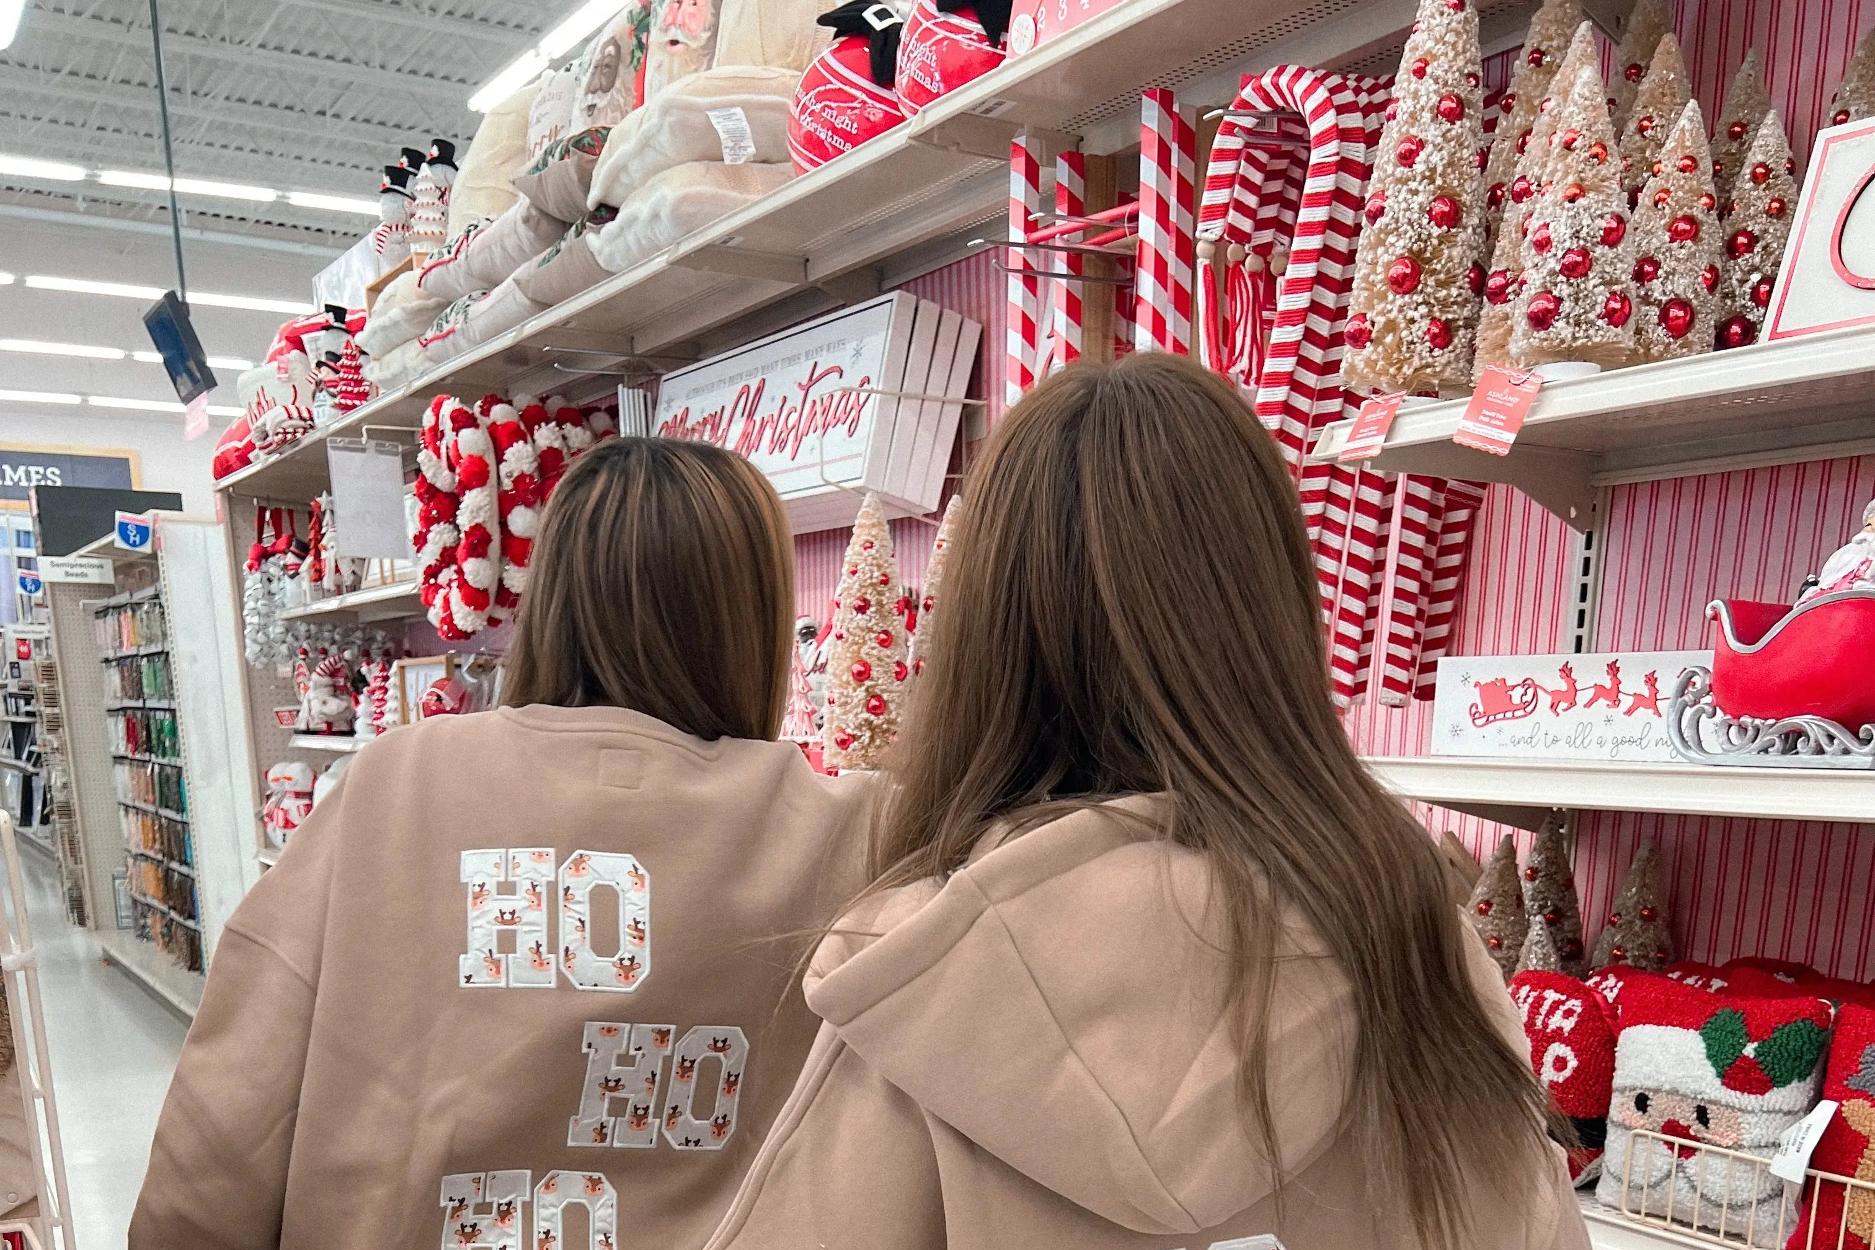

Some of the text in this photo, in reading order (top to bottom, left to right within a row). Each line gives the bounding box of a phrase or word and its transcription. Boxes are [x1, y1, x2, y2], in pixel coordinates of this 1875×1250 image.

[821, 107, 859, 135] night
[722, 360, 871, 462] Christmas
[0, 463, 63, 487] MES
[1544, 729, 1562, 749] to
[1565, 722, 1593, 749] all
[1596, 735, 1607, 748] a
[1609, 722, 1652, 759] good
[459, 847, 652, 993] HO
[567, 1021, 751, 1151] HO
